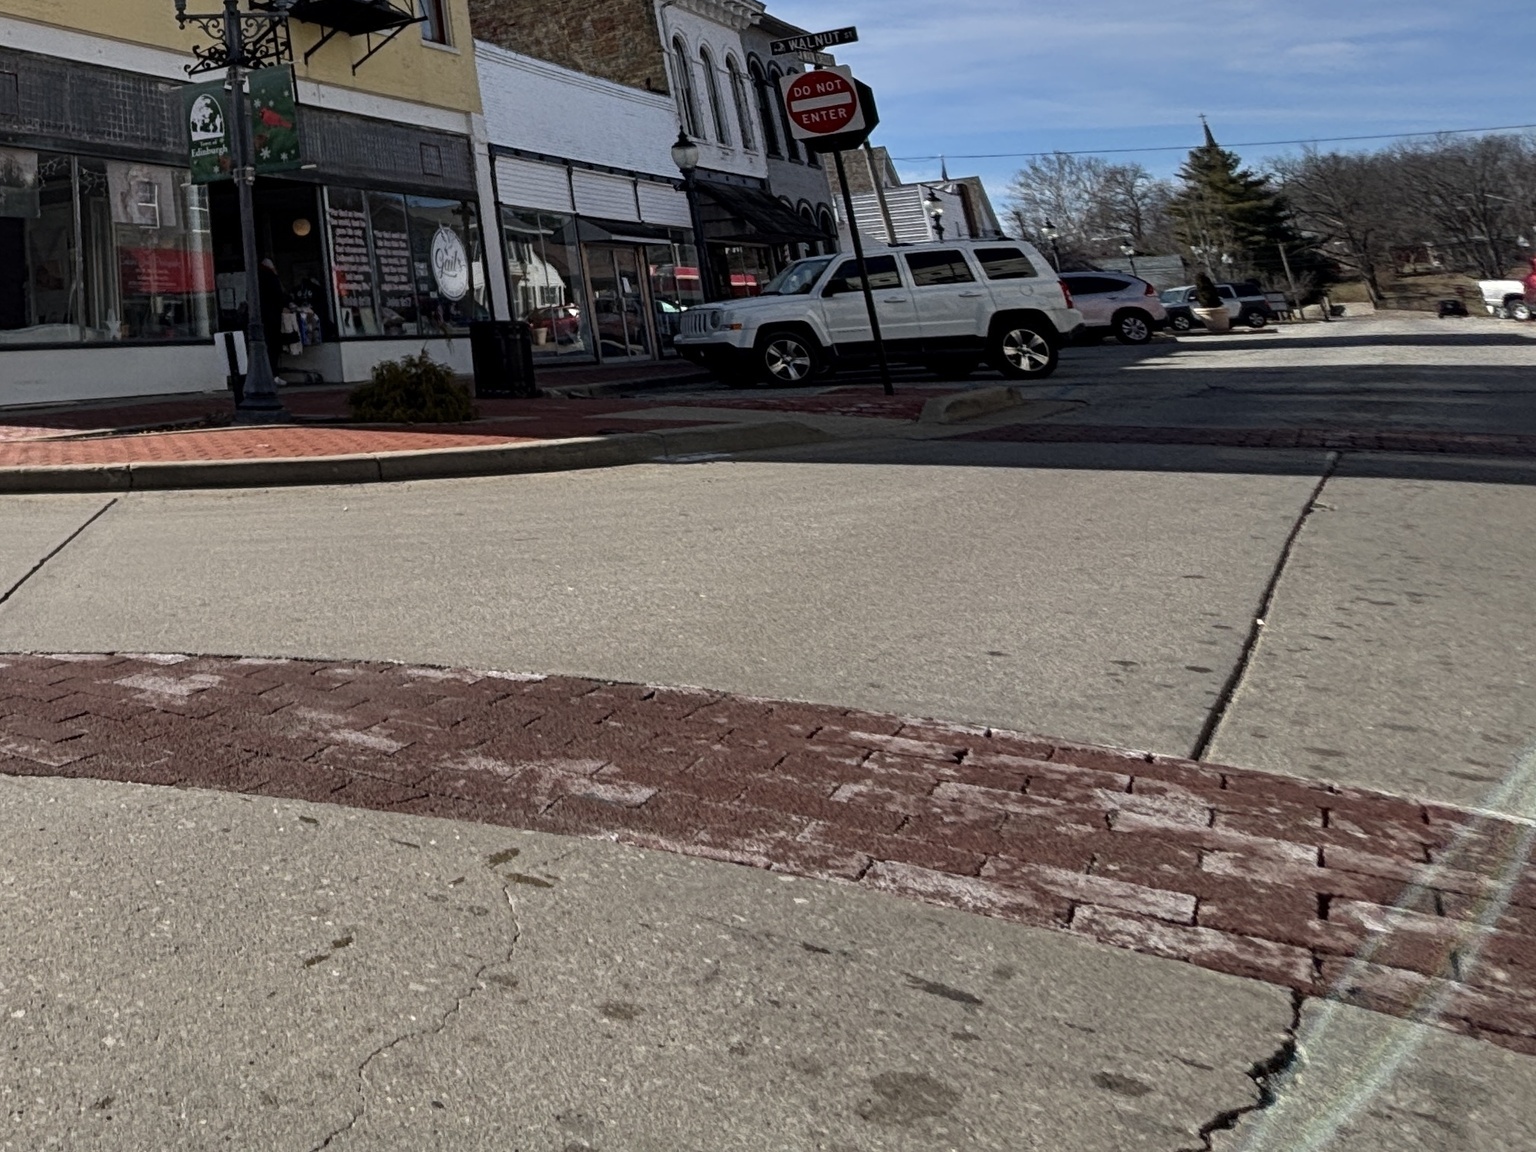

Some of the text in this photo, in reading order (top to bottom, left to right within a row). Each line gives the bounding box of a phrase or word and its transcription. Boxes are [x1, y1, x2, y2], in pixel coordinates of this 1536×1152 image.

[788, 31, 840, 51] WALNUT
[793, 79, 842, 98] DO NOT
[801, 108, 847, 124] ENTER
[191, 144, 228, 158] Edinburgh
